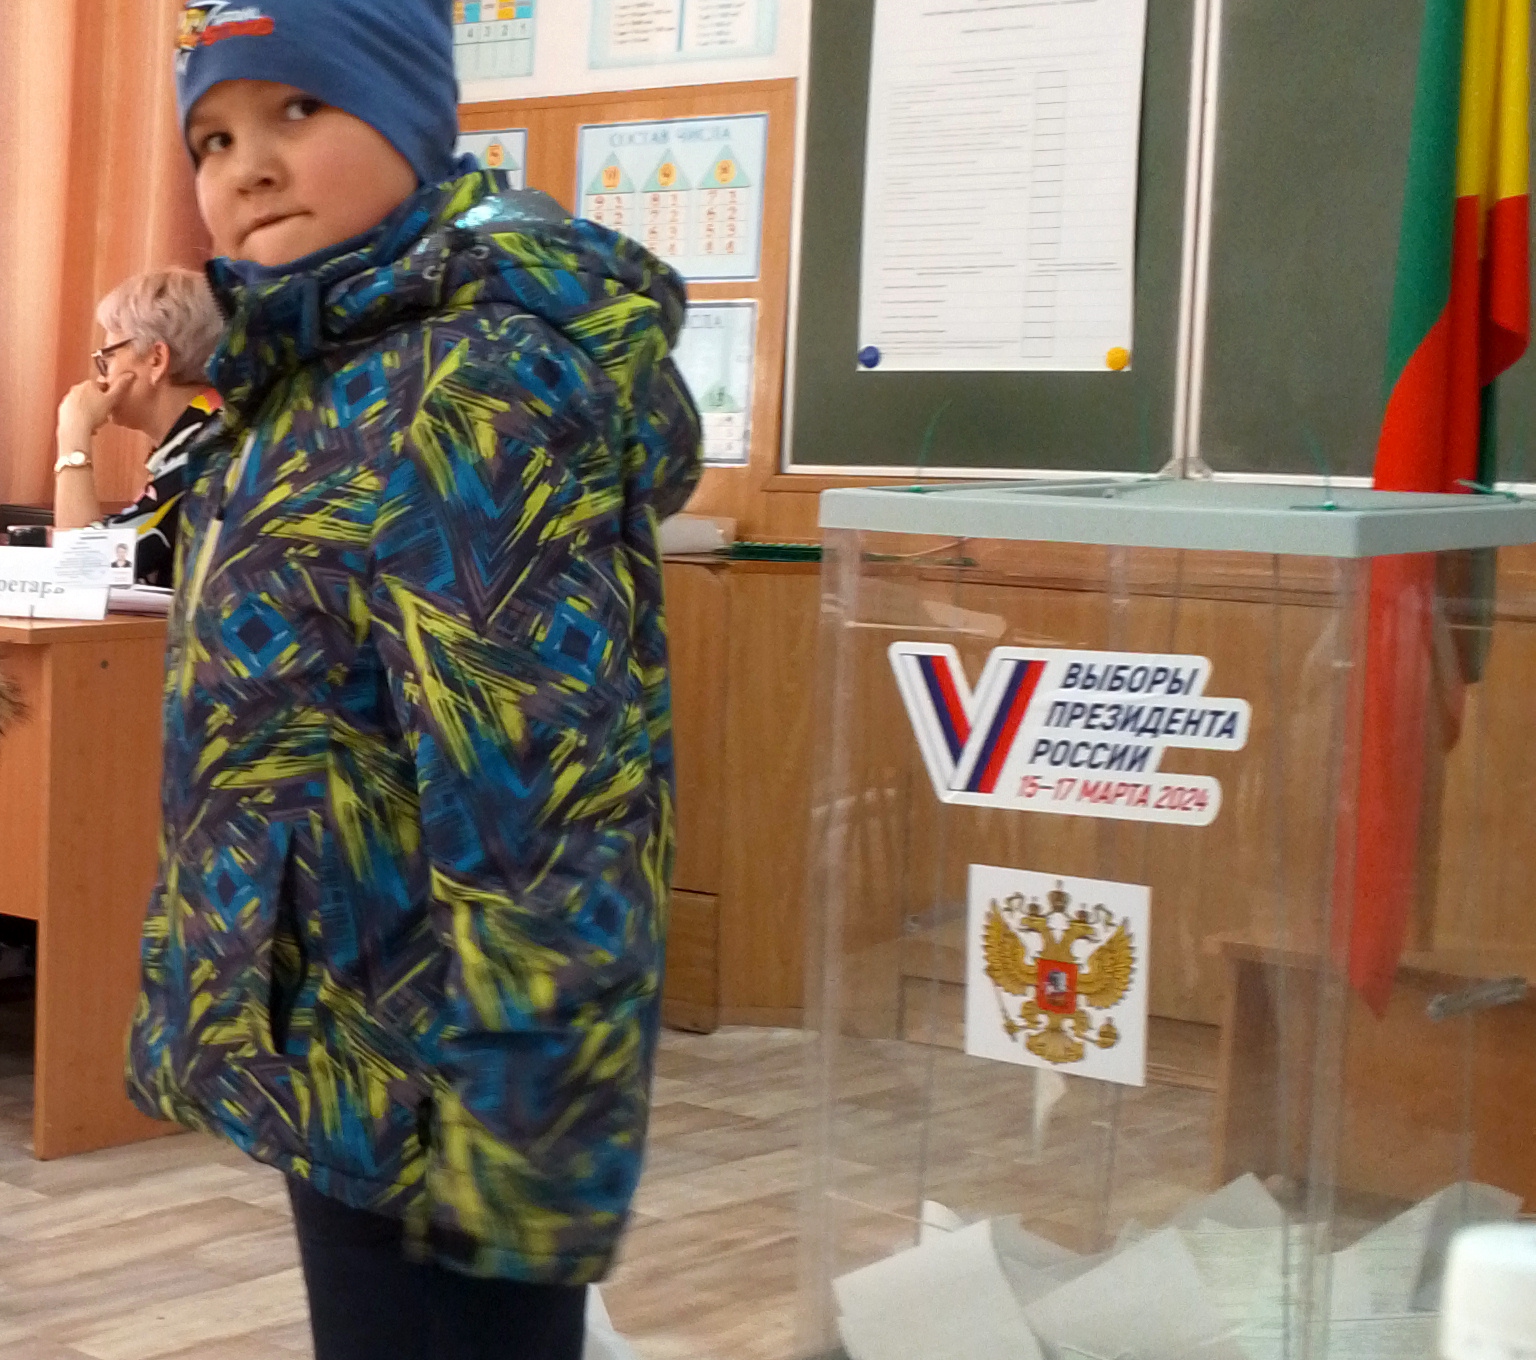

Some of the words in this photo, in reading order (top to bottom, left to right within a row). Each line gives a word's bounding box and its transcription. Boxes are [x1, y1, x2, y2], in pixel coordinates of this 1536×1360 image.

[1060, 662, 1200, 696] ВЫБОРЫ
[1044, 700, 1241, 739] ПРЕЗИДЕНТА
[1028, 739, 1154, 773] РОССИИ
[1077, 778, 1152, 807] МАРТА
[1152, 784, 1210, 813] 2024
